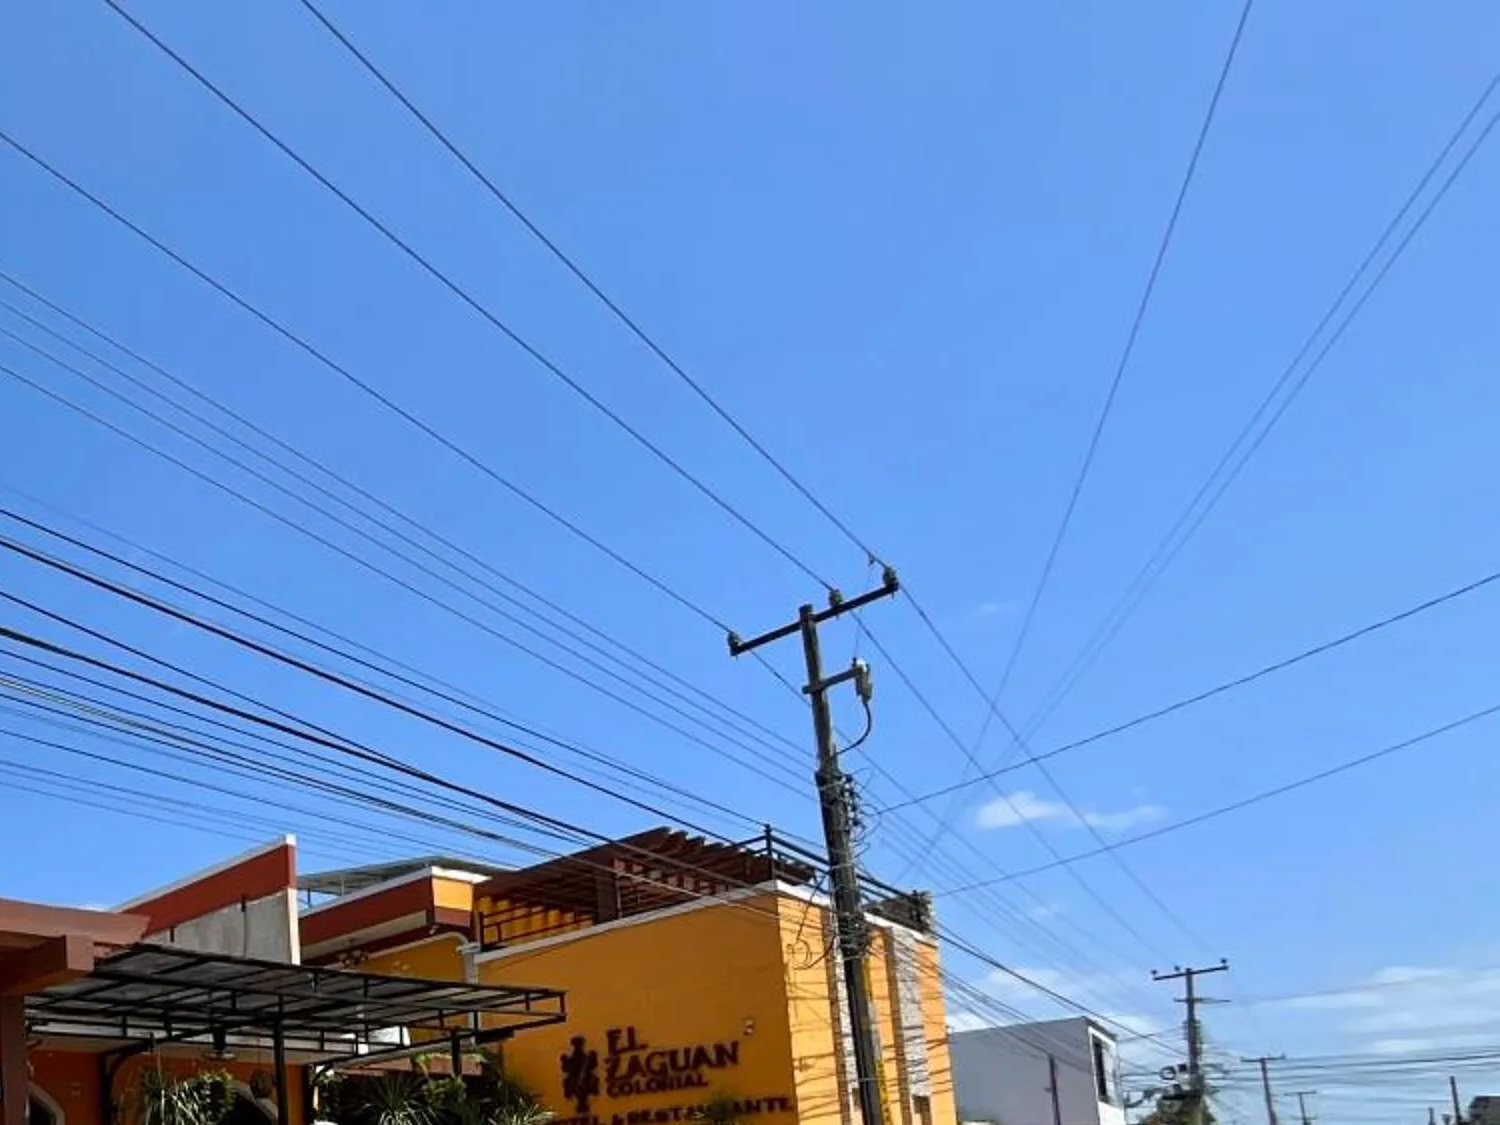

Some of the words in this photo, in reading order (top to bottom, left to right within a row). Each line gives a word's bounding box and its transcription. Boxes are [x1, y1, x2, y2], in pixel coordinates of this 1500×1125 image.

[606, 1026, 649, 1054] EL
[604, 1041, 739, 1080] ZAGUAN
[606, 1073, 708, 1097] COLONIAL
[627, 1096, 793, 1125] RESTANTE
